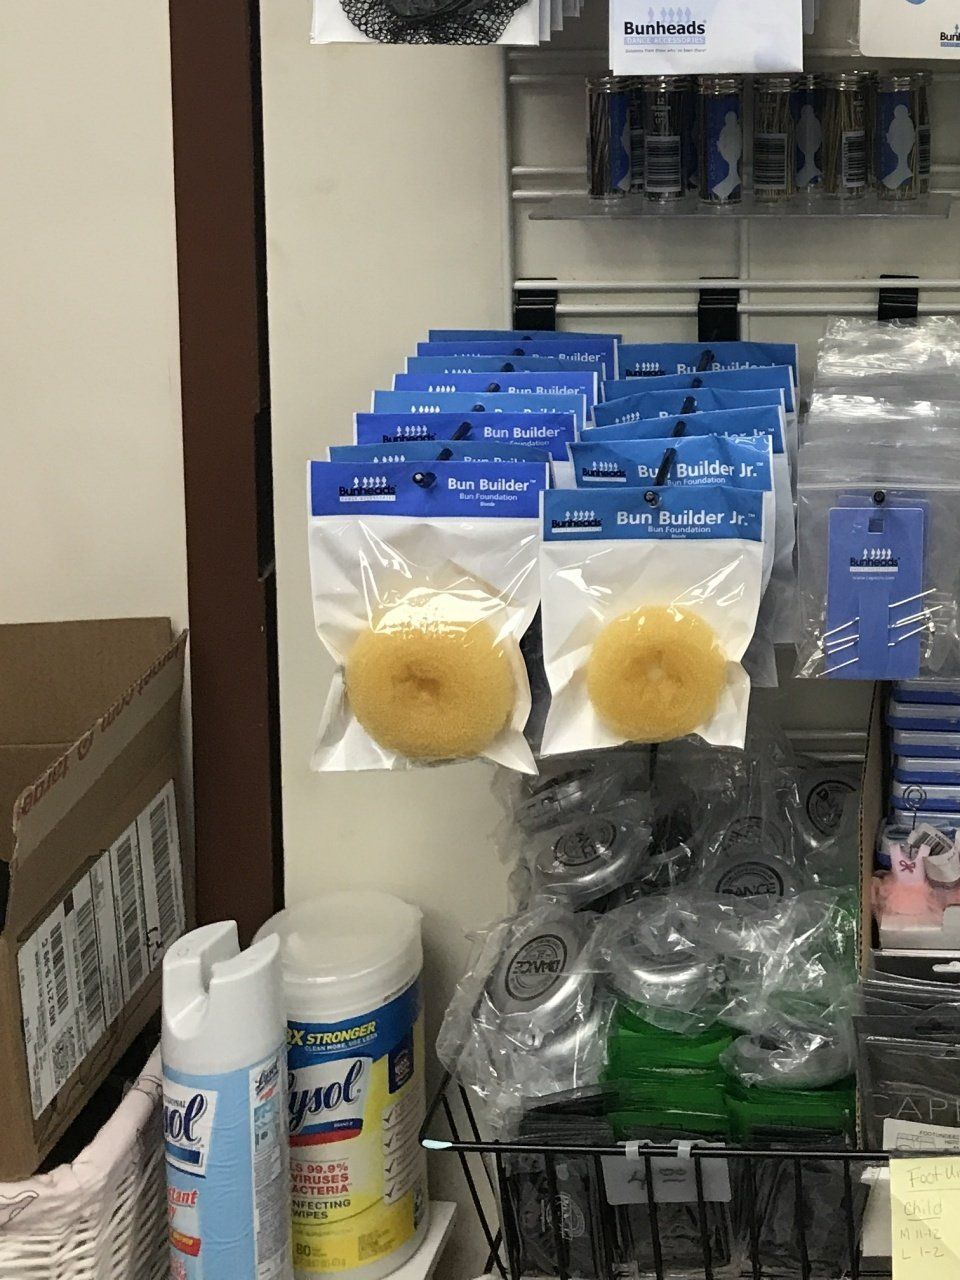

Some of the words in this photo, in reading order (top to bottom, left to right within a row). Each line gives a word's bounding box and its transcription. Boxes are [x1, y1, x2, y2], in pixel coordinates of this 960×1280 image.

[624, 20, 706, 35] Bunheads
[484, 427, 509, 438] Bun
[677, 460, 734, 477] Builder
[448, 478, 475, 490] Bun
[684, 477, 726, 485] Foundation
[339, 485, 396, 497] Bunheads
[476, 493, 518, 501] Foundation
[617, 511, 652, 525] Bun
[659, 510, 725, 525] Builder
[552, 520, 602, 528] Bunheads
[850, 557, 899, 567] Bunheads
[306, 1021, 377, 1045] STRONGER
[307, 1162, 349, 1174] 99.9%
[290, 1173, 349, 1184] VIRUSES
[292, 1199, 351, 1210] NFECTING
[903, 1200, 943, 1216] Child
[292, 1210, 329, 1219] WIPES
[900, 1228, 910, 1240] M
[296, 1243, 311, 1257] 80
[902, 1249, 911, 1259] L
